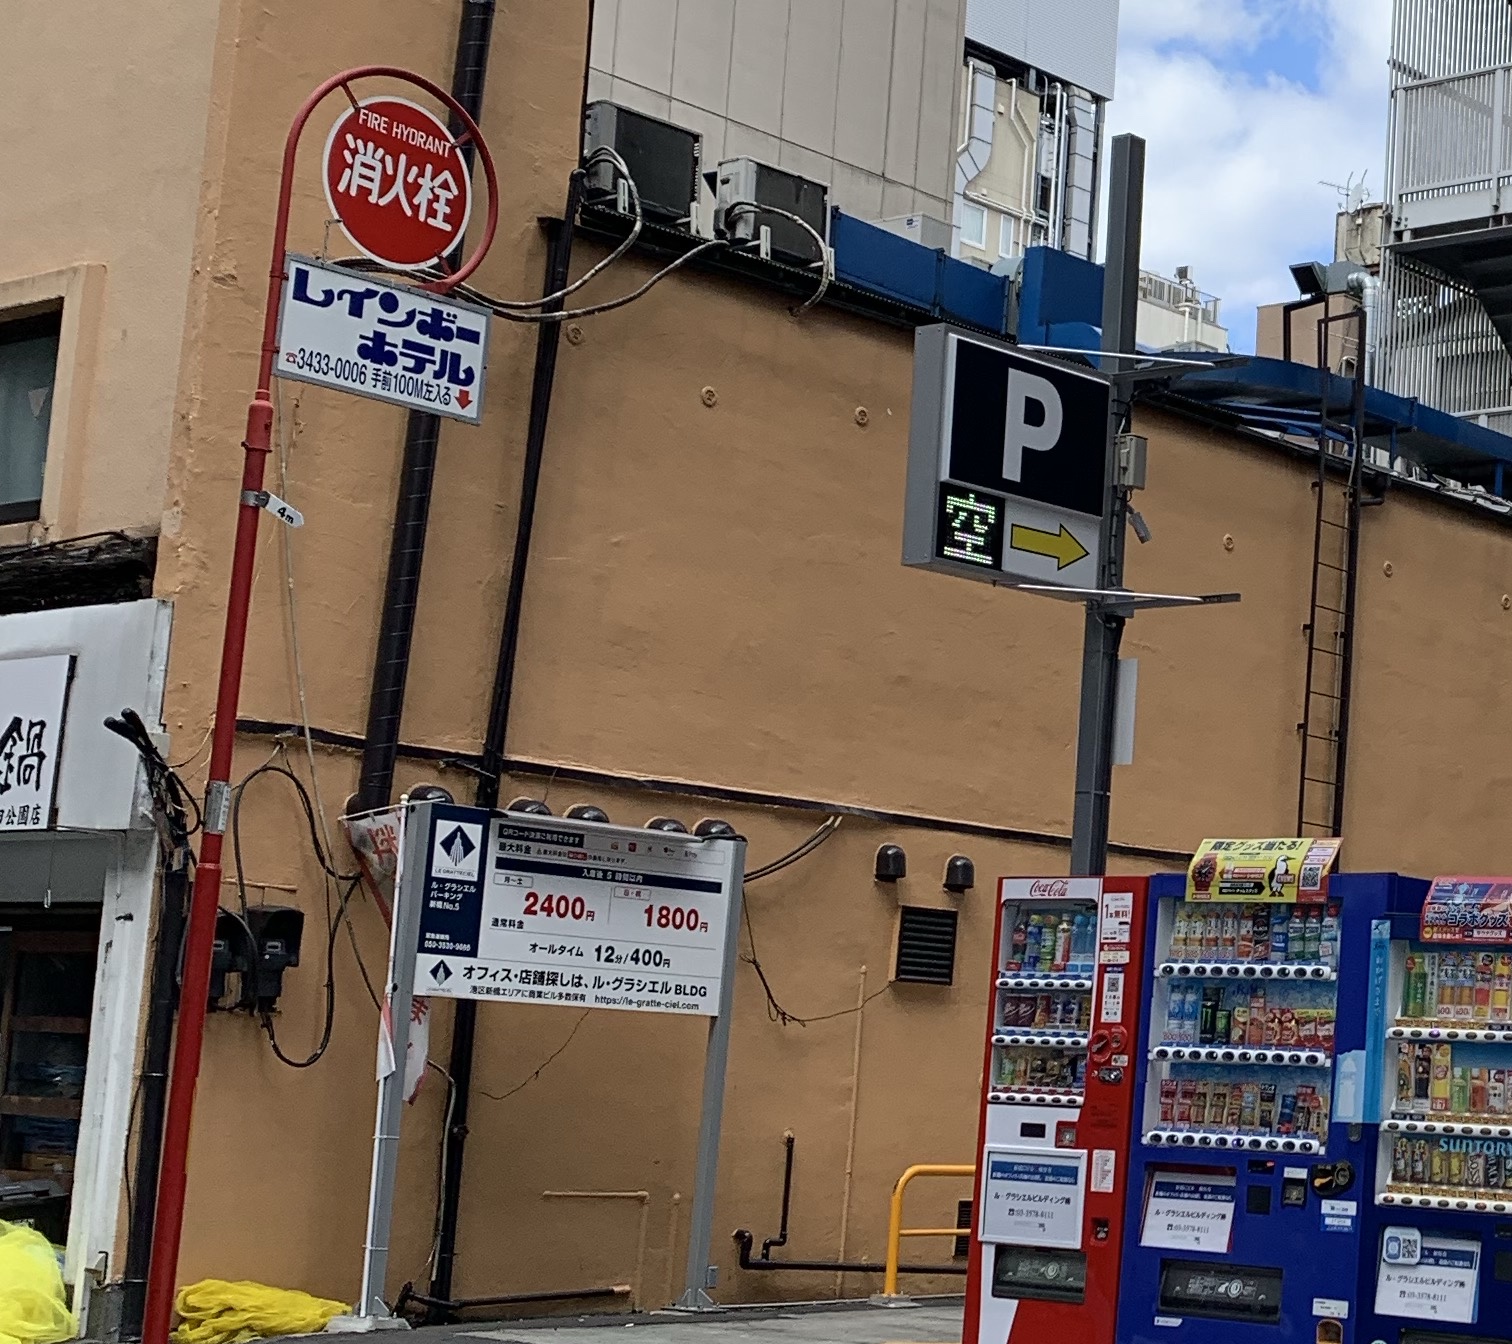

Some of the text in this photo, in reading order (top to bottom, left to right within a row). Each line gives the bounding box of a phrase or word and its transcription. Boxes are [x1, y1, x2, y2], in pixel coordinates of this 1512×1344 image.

[357, 108, 451, 158] FIRE HYDRANT
[337, 132, 459, 232] 消火栓
[291, 267, 480, 345] レインボー
[356, 329, 475, 387] ホテル
[296, 348, 451, 406] 3433-0006 手前100M左入る
[1002, 367, 1063, 482] P
[277, 506, 294, 525] 4m
[430, 890, 463, 901] パーキング
[431, 881, 477, 893] ル・グラシエル
[523, 891, 595, 922] 2400円
[643, 904, 709, 933] 1800円
[491, 917, 524, 930] 通常料金
[528, 942, 584, 957] オールタイム
[594, 995, 699, 1011] https://le-gratte-ciel.com
[674, 984, 707, 997] BLDG
